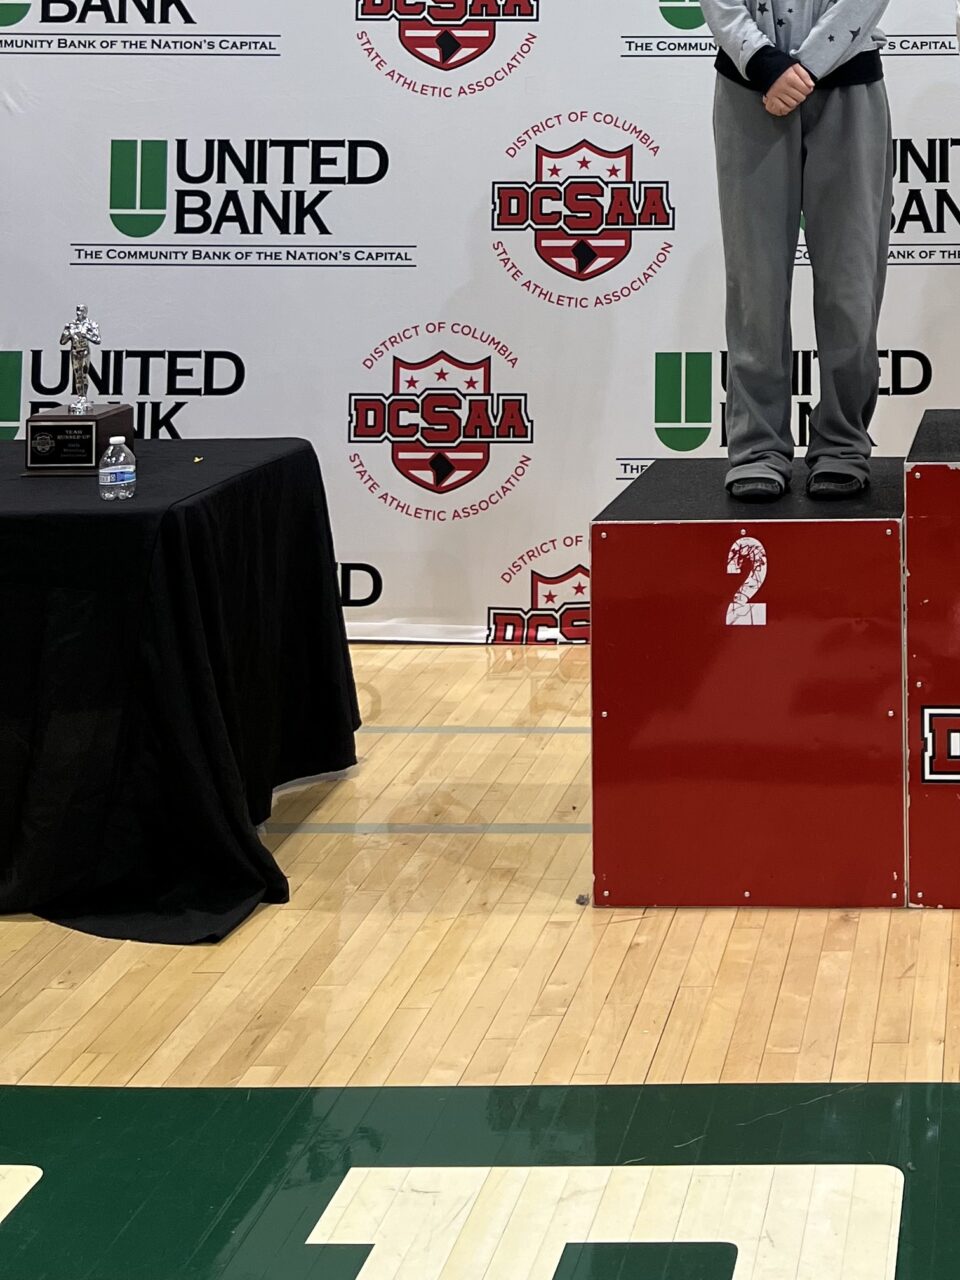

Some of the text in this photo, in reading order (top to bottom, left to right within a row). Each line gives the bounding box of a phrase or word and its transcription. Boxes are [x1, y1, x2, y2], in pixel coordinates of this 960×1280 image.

[357, 30, 538, 98] STATE ATHLETIC ASSOCIATION
[505, 111, 661, 158] DISTRICT OF COLUMBIA
[176, 139, 389, 185] UNITED
[174, 190, 332, 235] BANK
[492, 176, 675, 236] DCSAA
[75, 249, 412, 260] THE COMMUNITY BANK OF THE NATION'S CAPITAL
[492, 240, 673, 309] STATE ATHLETIC ASSOCIATION
[31, 349, 246, 396] UNITED
[363, 322, 519, 370] DISTRICT OF COLUMBIA
[348, 388, 533, 447] DCSAA
[349, 453, 531, 522] STATE ATHLETIC ASSOCIATION
[725, 536, 768, 626] 2
